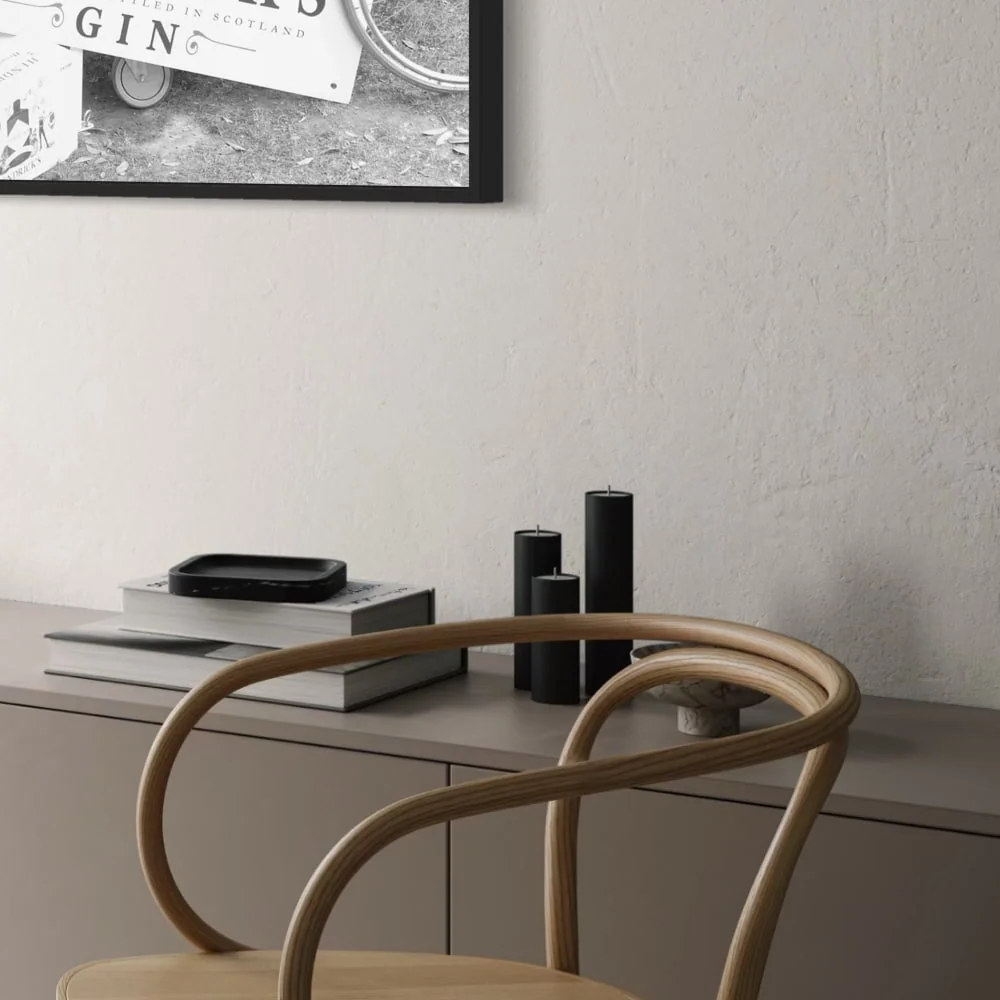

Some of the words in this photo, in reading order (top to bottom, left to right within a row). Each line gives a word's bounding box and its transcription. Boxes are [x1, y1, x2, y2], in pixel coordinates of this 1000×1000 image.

[76, 6, 180, 55] GIN
[184, 6, 202, 18] IN
[213, 12, 306, 39] SCOTLAND
